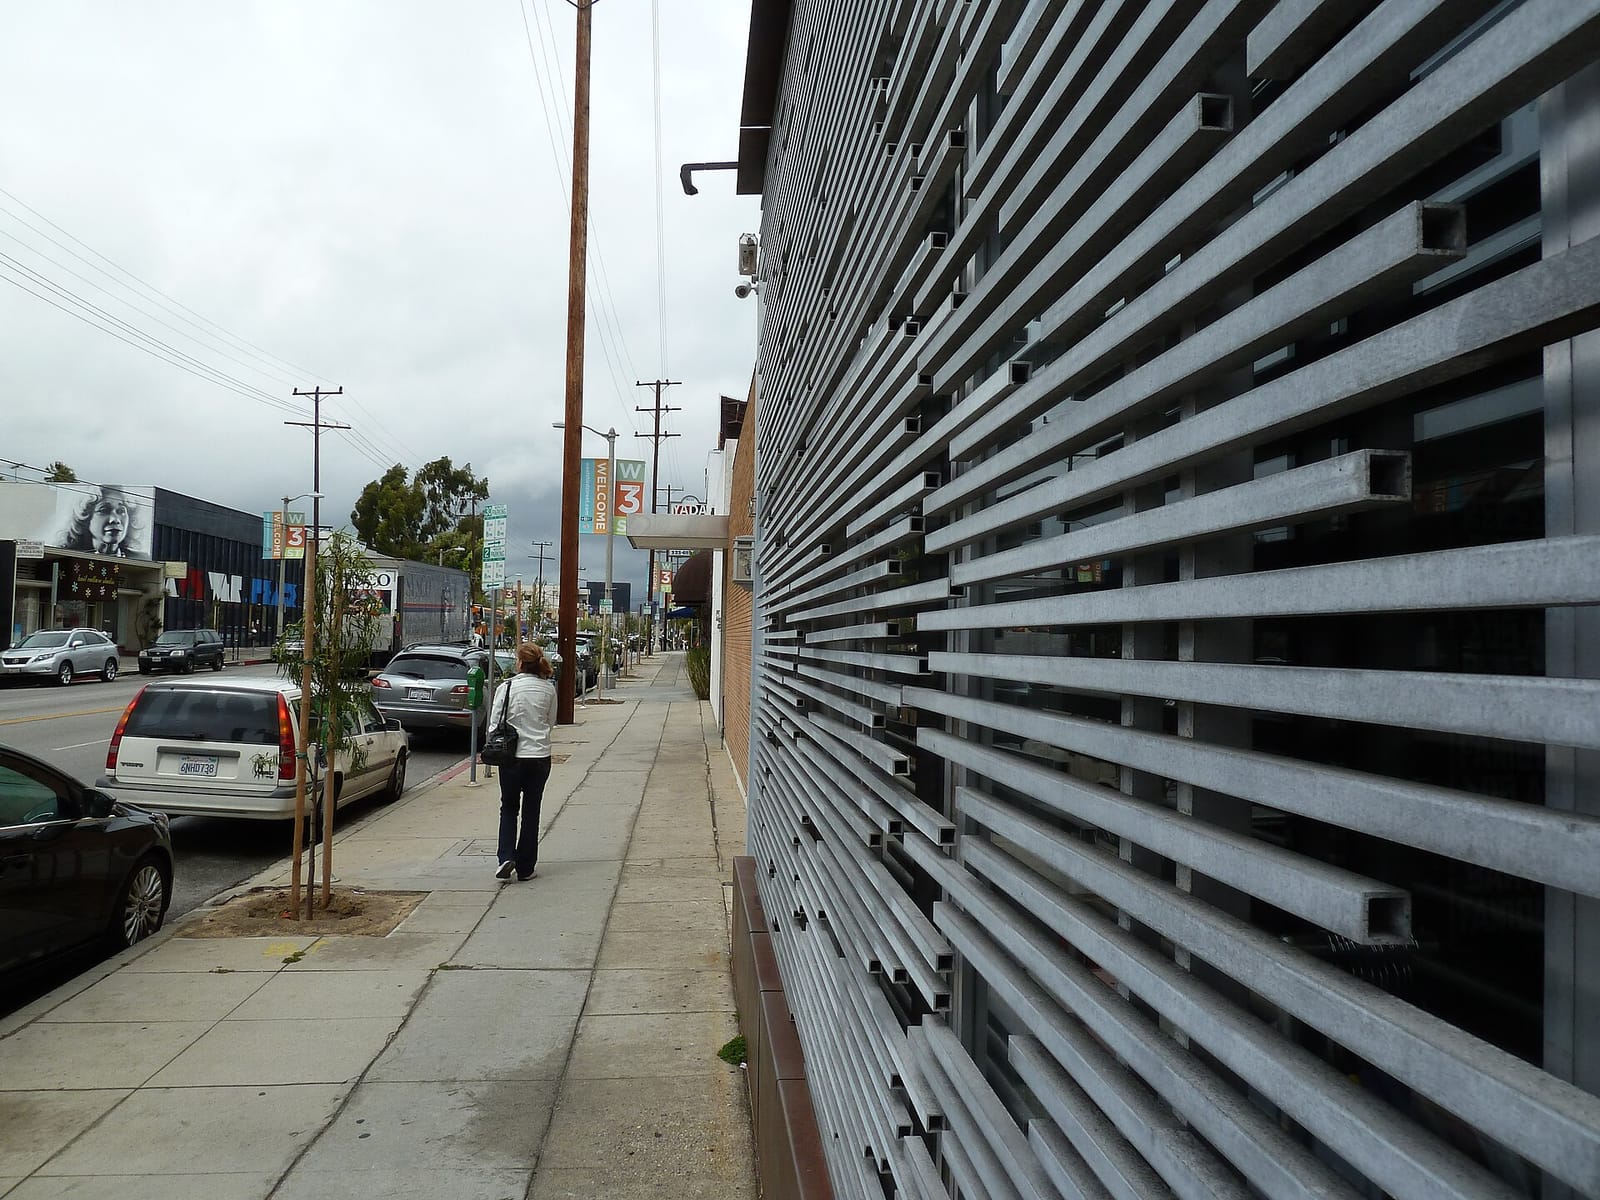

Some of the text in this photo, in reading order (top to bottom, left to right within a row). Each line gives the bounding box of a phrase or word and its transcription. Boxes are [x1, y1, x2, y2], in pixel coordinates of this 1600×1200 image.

[619, 462, 642, 480] W
[595, 463, 606, 530] WELCOME
[618, 484, 641, 515] 3
[288, 513, 303, 524] W
[288, 527, 303, 546] 3
[484, 547, 490, 558] 2
[661, 571, 671, 584] 3
[505, 589, 513, 598] 3
[180, 762, 215, 774] 6NHD738
